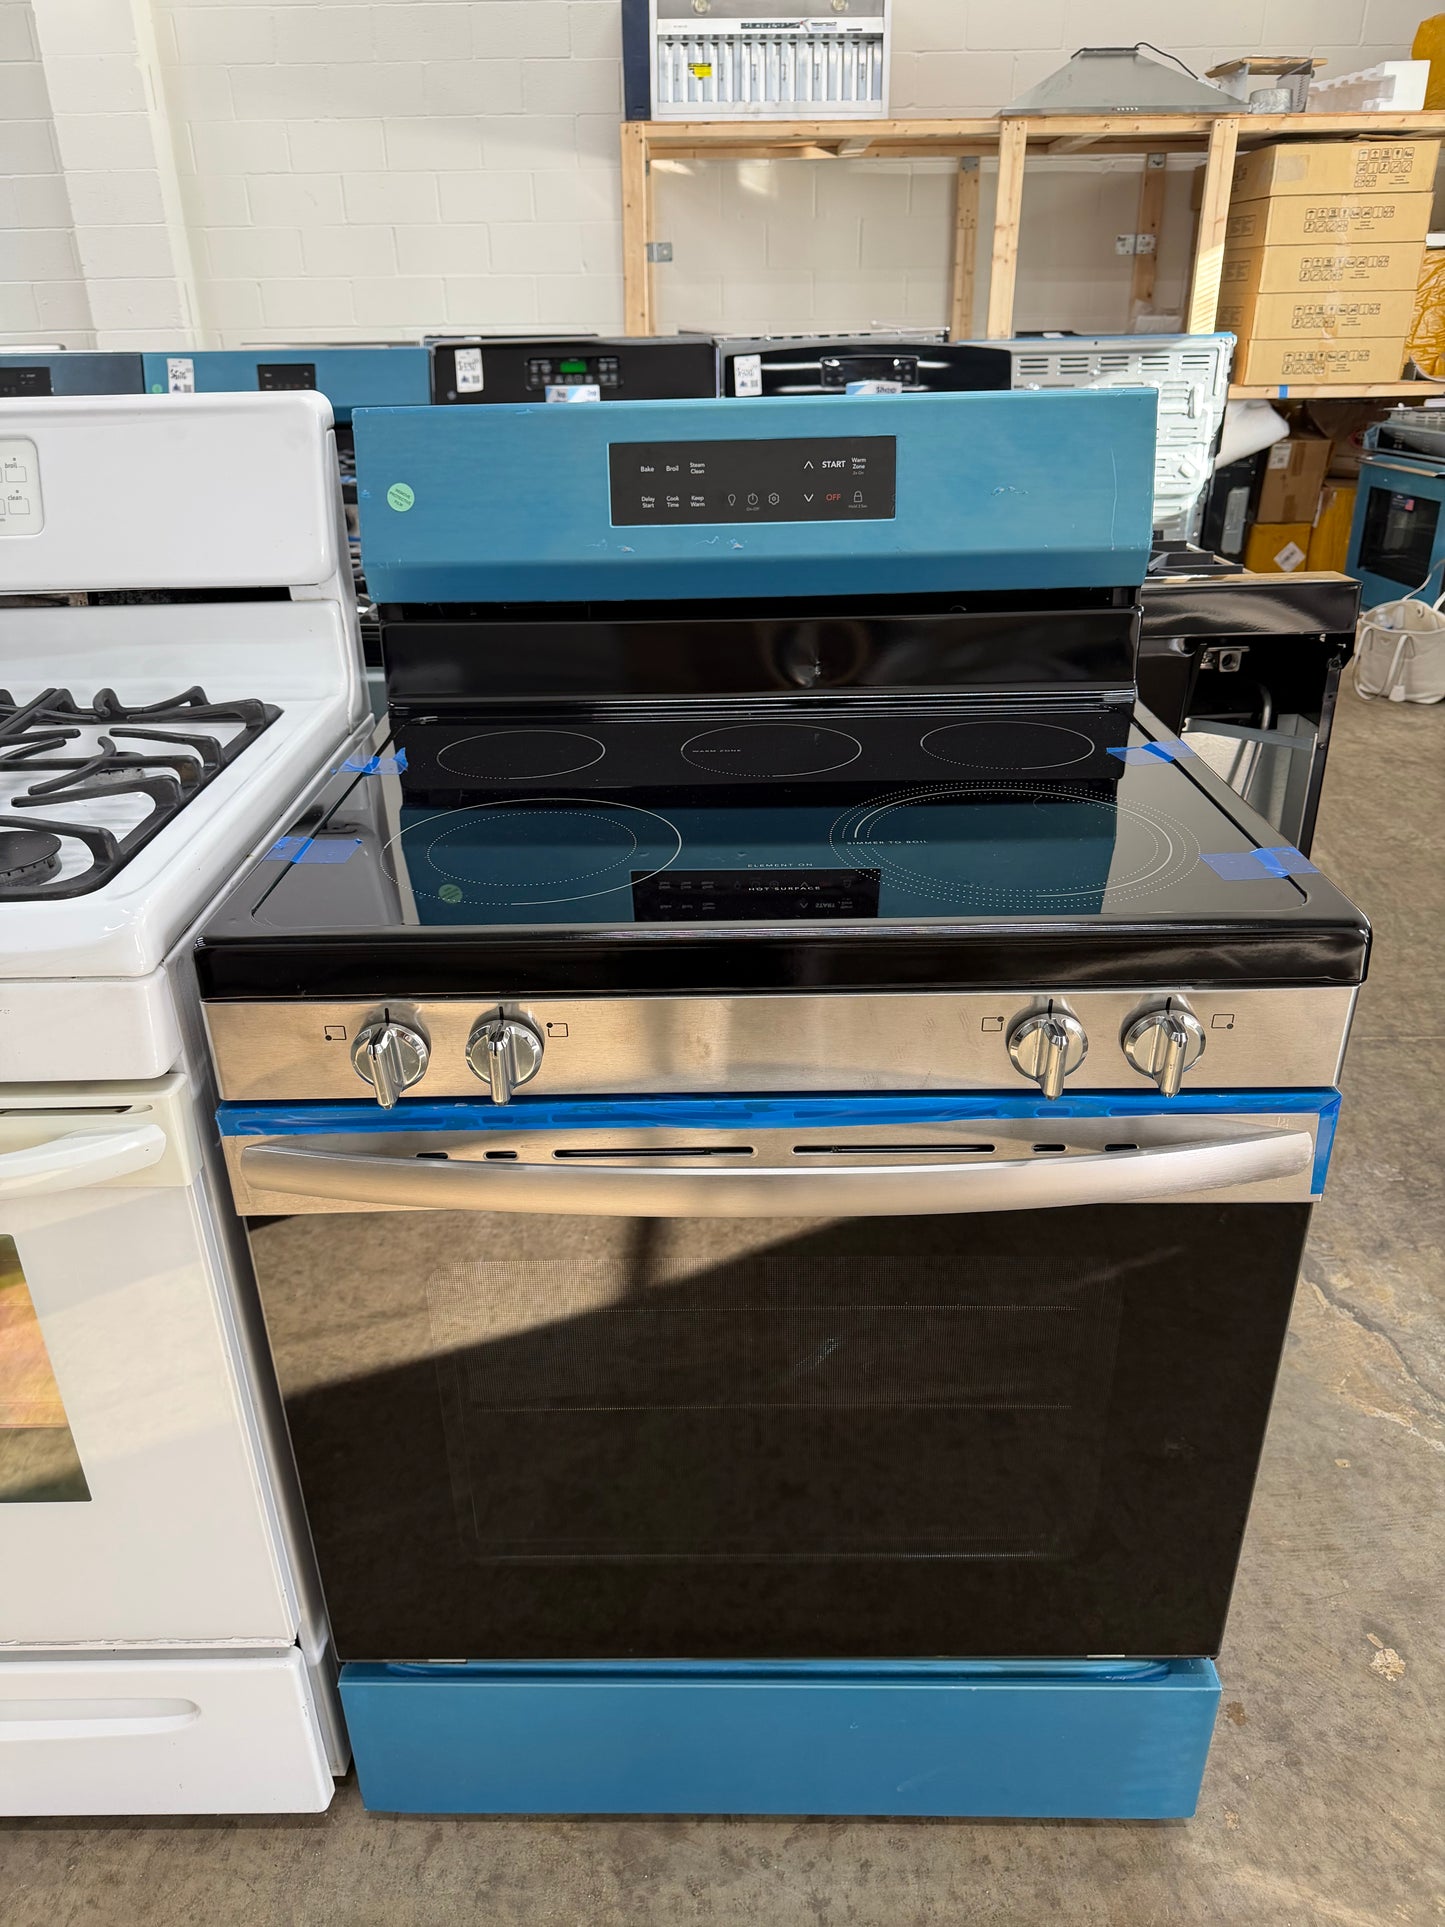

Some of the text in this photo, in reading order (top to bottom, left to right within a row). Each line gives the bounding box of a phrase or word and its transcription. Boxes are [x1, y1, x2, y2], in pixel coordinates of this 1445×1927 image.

[822, 460, 846, 469] START
[640, 465, 655, 473] Bake
[825, 493, 841, 501] OFF
